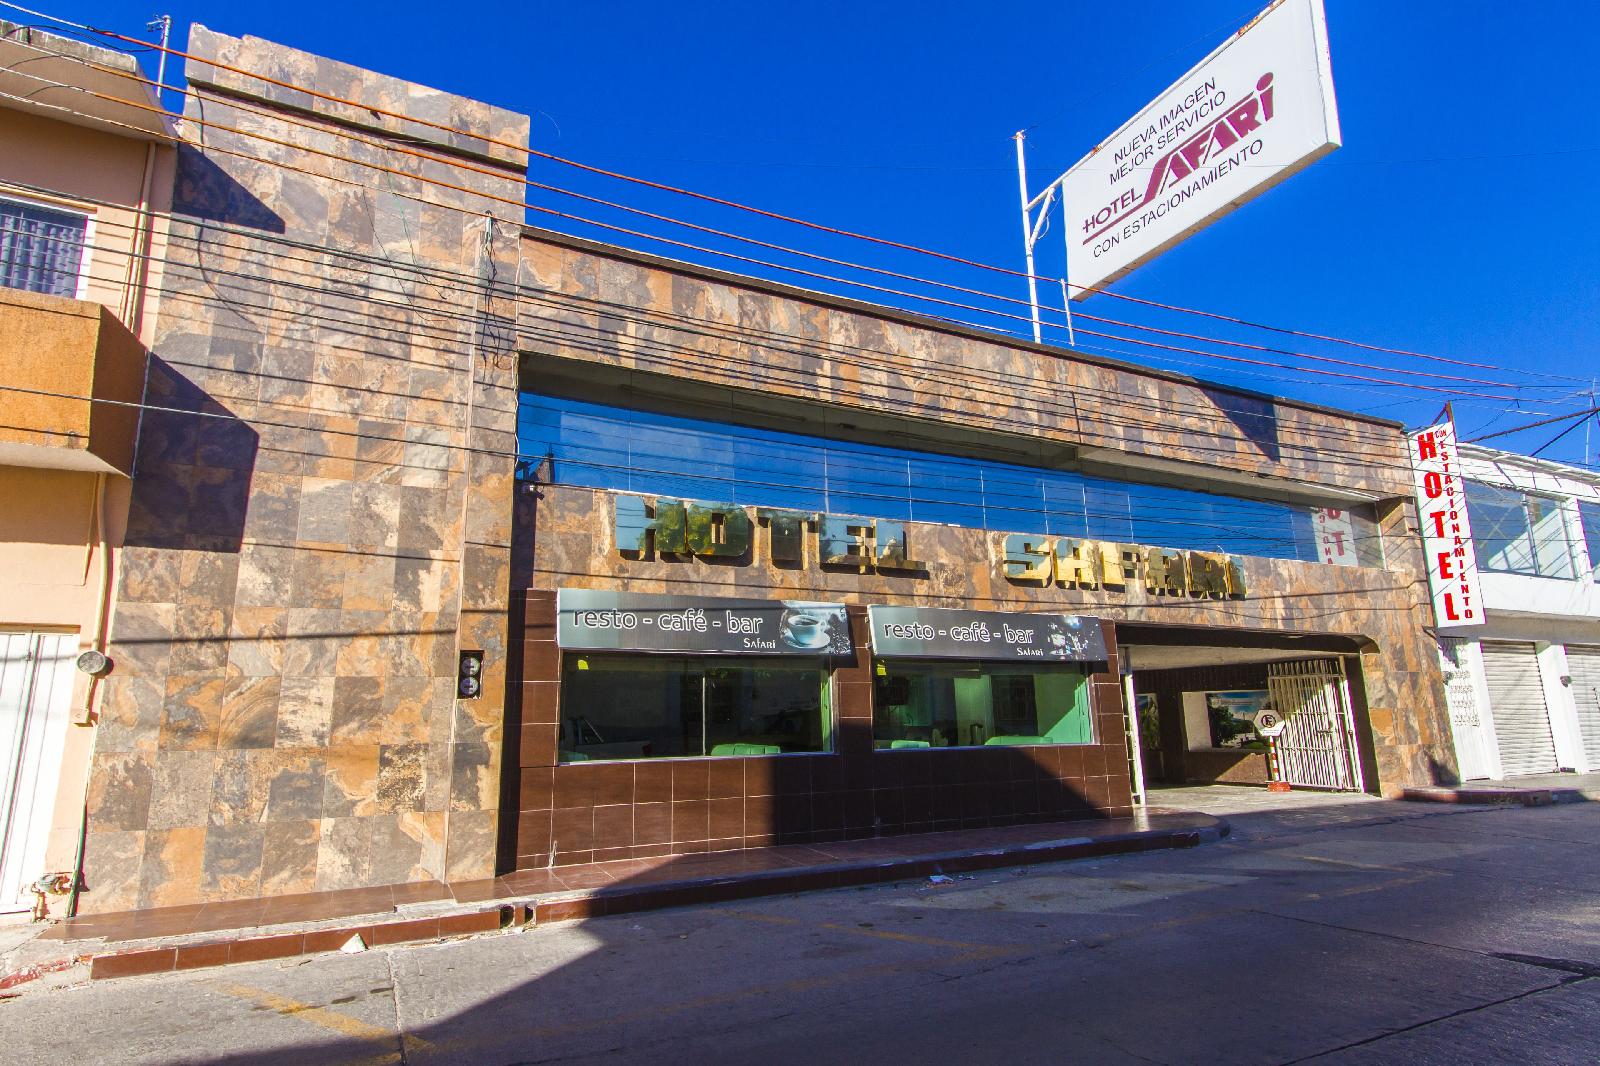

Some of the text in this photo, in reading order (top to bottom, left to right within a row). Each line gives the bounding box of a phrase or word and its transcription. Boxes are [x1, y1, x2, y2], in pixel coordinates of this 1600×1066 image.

[1109, 91, 1226, 185] MEJOR SERVICIO
[1114, 77, 1217, 164] NUEVA IMAGEN
[1082, 187, 1143, 234] HOTEL
[1093, 138, 1263, 258] CON ESTACIONAMIENTO
[1417, 431, 1460, 621] HOTEL
[1439, 440, 1473, 619] ESTACIONAMIENTO
[573, 608, 638, 630] resto
[657, 608, 708, 633] café
[726, 610, 764, 634] bar
[883, 621, 936, 641] resto
[949, 622, 991, 642] café
[1003, 623, 1035, 644] bar
